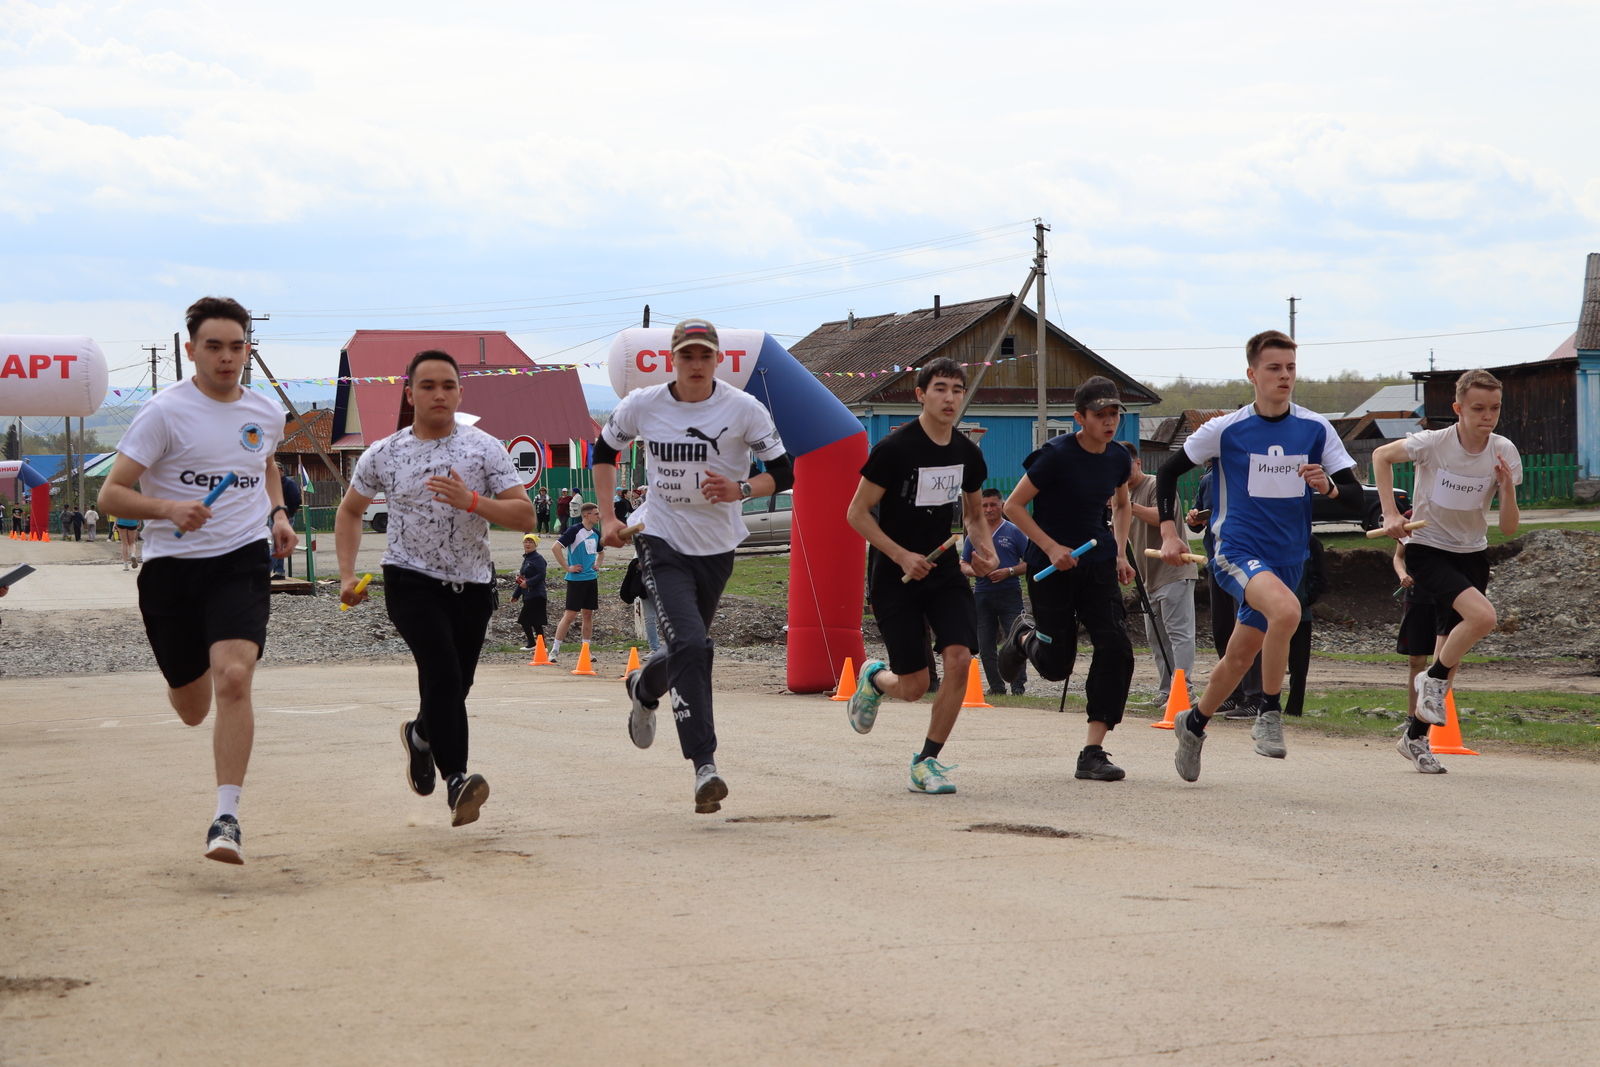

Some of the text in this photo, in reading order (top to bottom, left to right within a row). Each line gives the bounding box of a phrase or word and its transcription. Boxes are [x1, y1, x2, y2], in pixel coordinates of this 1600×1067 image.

[0, 354, 78, 379] АРТ
[636, 350, 747, 373] СТТ
[649, 440, 707, 462] PUMA
[657, 465, 686, 477] МОБУ
[1258, 463, 1300, 475] Инзер-1
[1441, 478, 1484, 493] Инзер-2
[1247, 559, 1262, 571] 2
